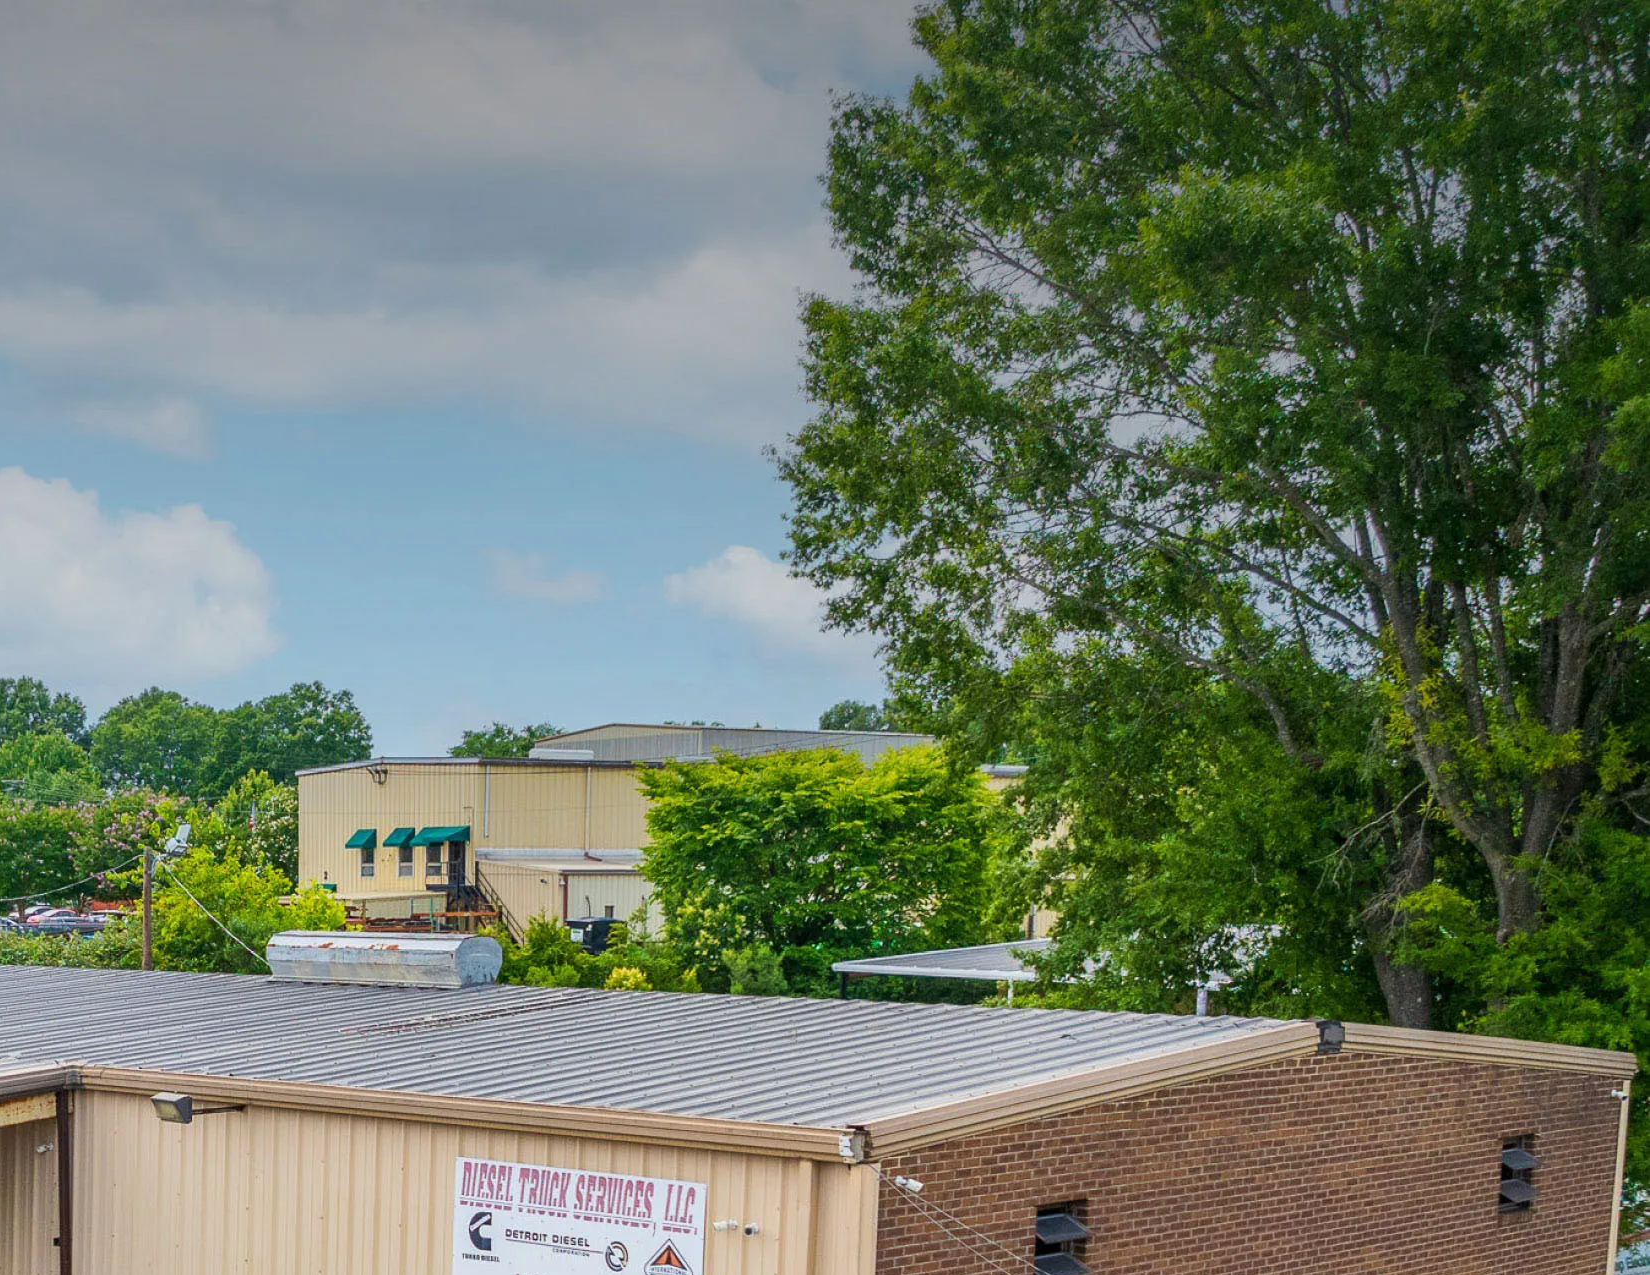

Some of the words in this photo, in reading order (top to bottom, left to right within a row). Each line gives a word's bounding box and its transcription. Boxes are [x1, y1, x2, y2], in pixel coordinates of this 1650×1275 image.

[459, 1161, 514, 1211] DIESEL
[518, 1167, 571, 1218] TRUCK
[505, 1228, 548, 1242] DETROIT
[552, 1234, 590, 1248] DIESEL
